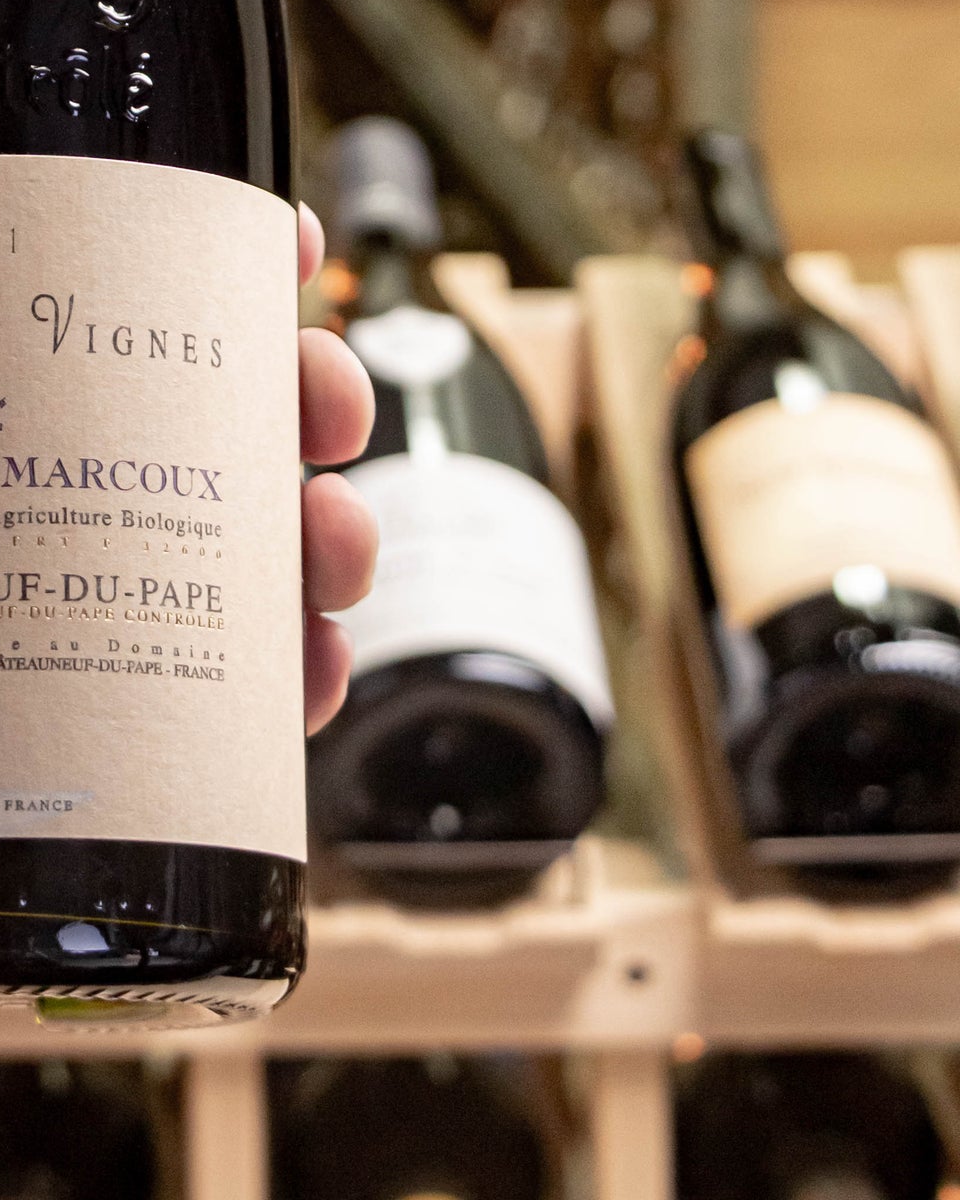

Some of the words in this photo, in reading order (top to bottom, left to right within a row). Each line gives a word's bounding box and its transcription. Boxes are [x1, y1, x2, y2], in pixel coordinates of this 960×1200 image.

[1, 456, 223, 502] MARCOUX
[121, 509, 223, 540] Biologique
[50, 639, 79, 651] au
[108, 639, 225, 662] Domaine
[174, 663, 225, 682] FRANCE
[4, 800, 73, 812] FRANCE
